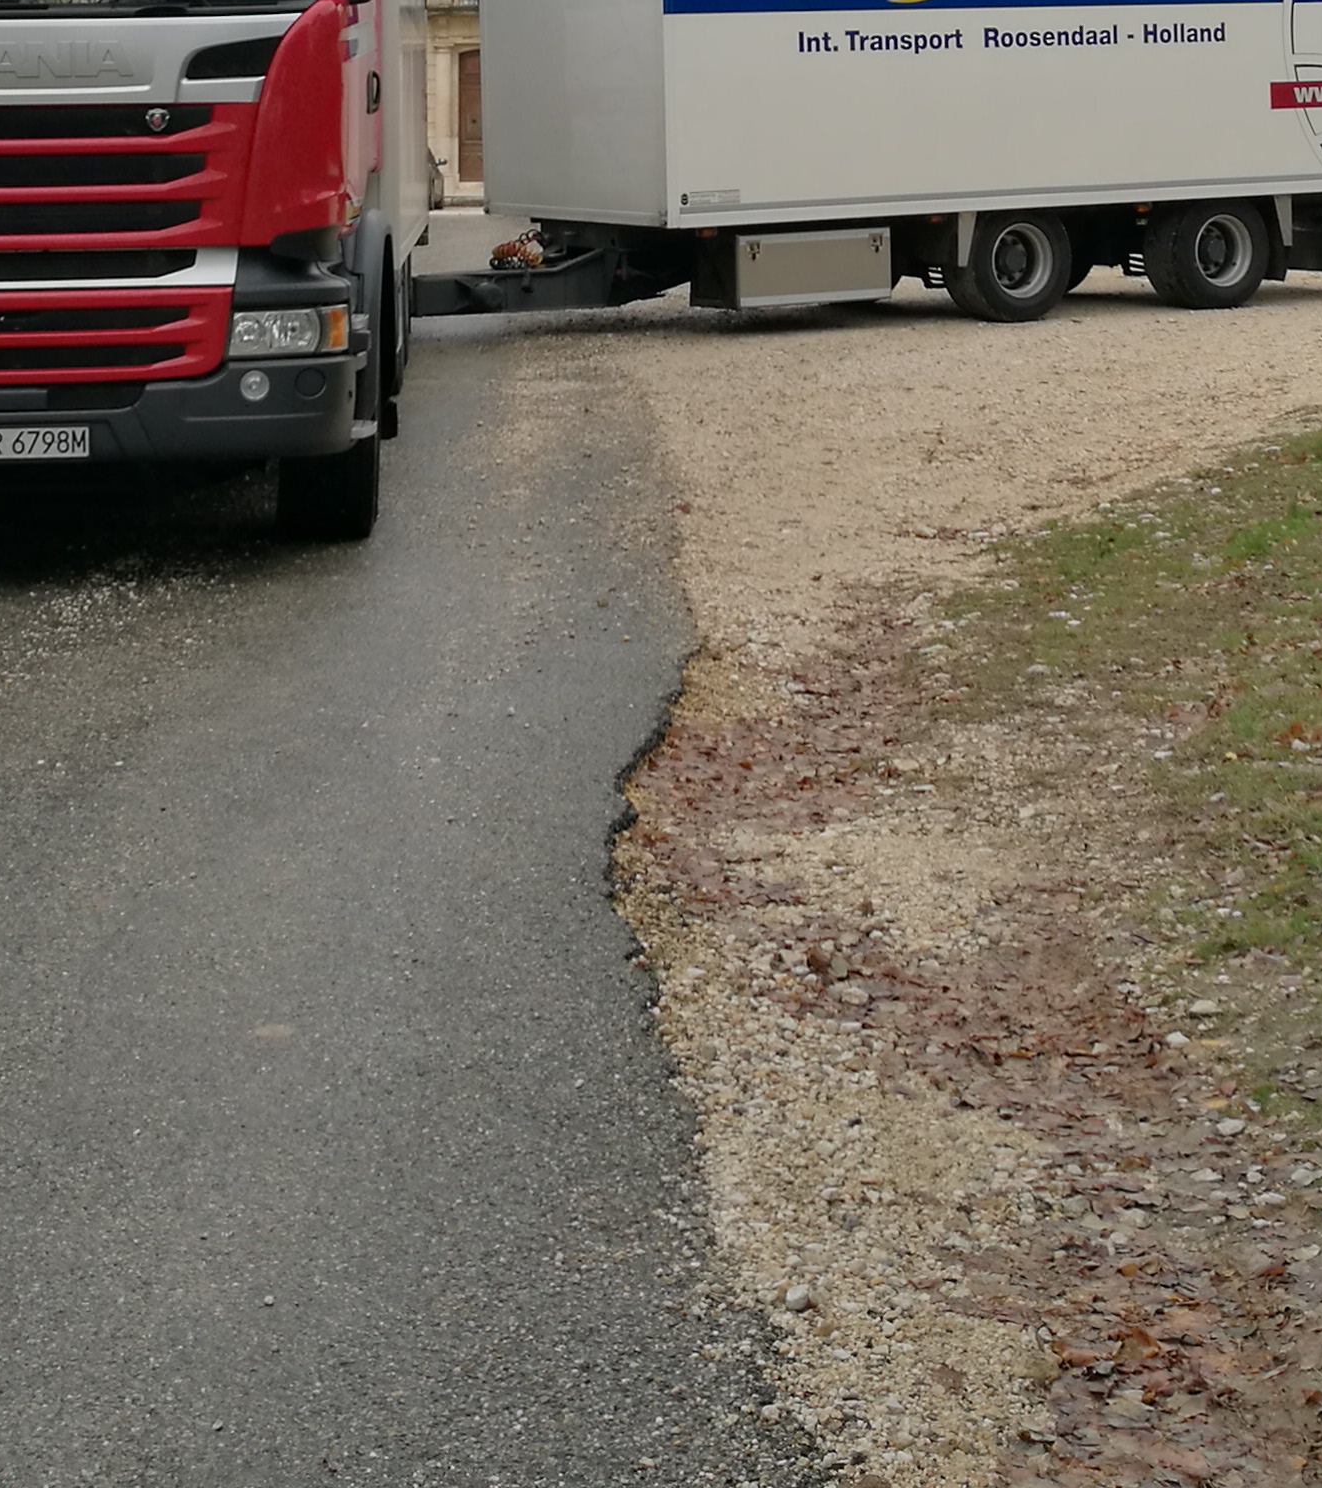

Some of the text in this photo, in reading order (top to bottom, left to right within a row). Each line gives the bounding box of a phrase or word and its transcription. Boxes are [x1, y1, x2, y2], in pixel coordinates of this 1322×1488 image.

[798, 31, 839, 53] Int.
[845, 29, 963, 55] Transport
[983, 24, 1119, 49] Roosendaal
[1143, 22, 1226, 44] Holland
[12, 429, 87, 455] 6798M
